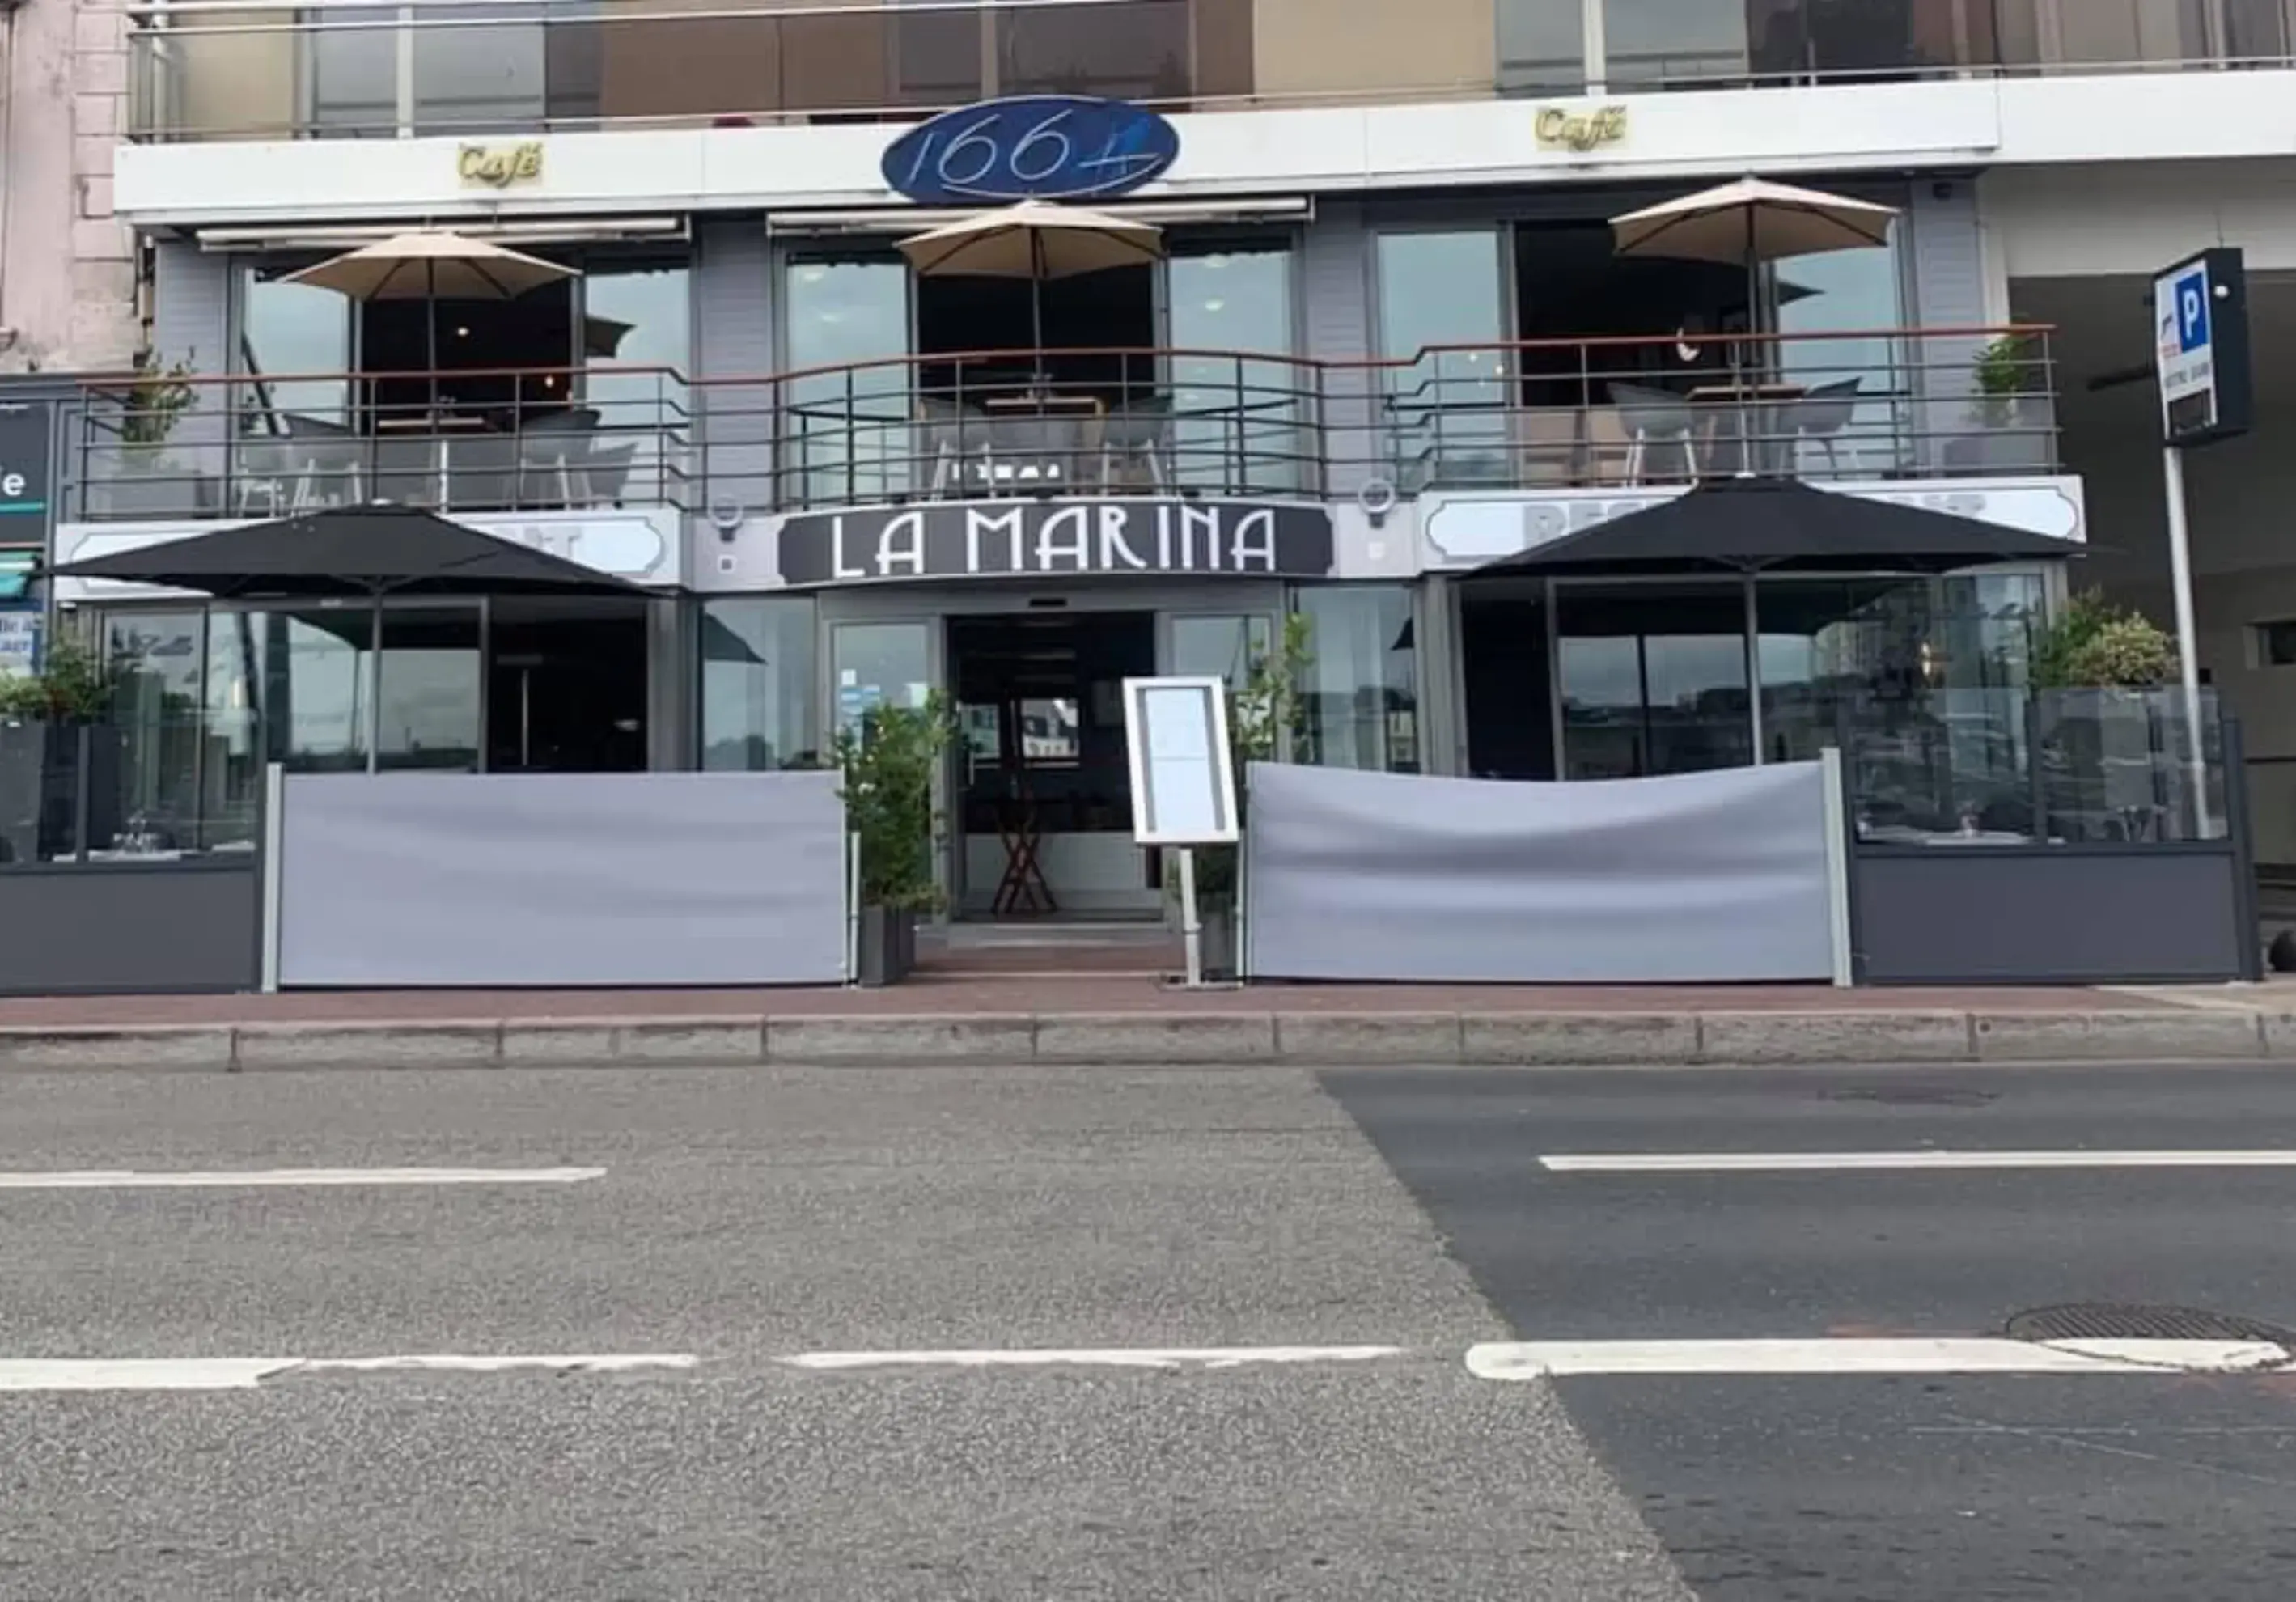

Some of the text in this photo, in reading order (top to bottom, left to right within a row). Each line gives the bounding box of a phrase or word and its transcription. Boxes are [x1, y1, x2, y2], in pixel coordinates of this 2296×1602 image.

[1536, 105, 1626, 151] Café
[458, 142, 542, 189] Café
[2184, 289, 2200, 341] P
[832, 506, 1275, 578] LA MARINA
